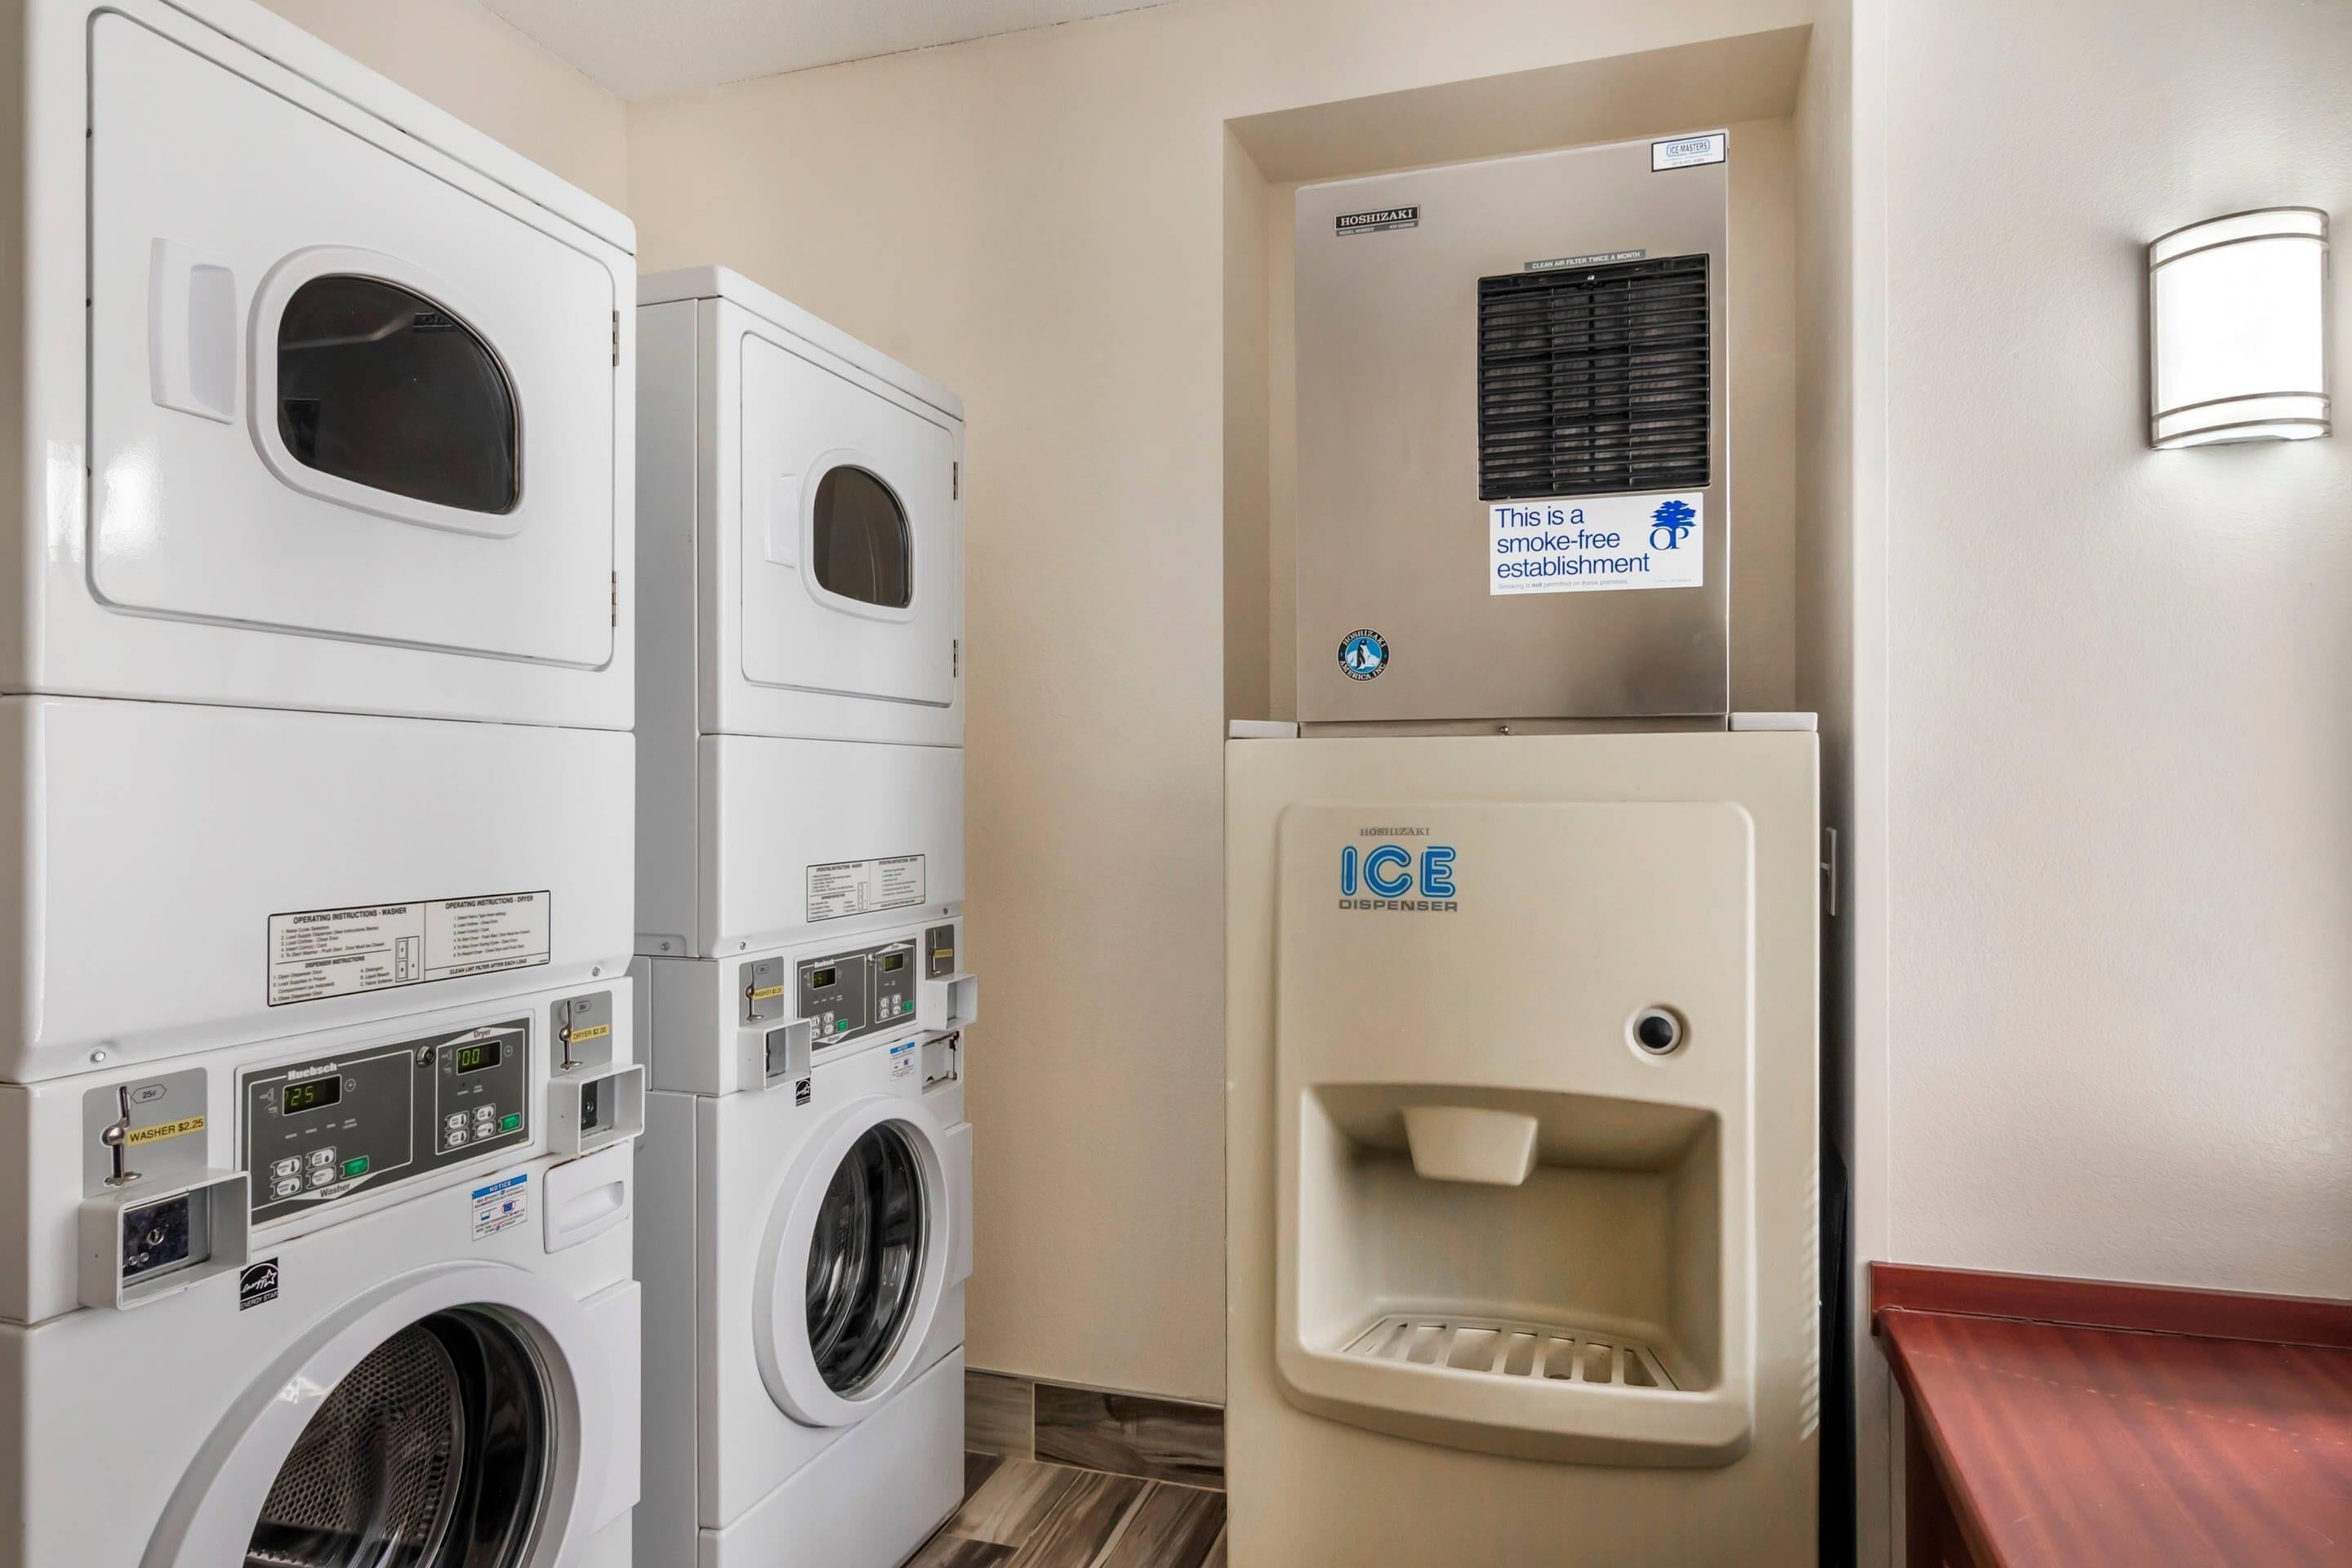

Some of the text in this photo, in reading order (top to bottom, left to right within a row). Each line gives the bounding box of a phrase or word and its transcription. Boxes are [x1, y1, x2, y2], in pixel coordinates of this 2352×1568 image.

[1670, 142, 1707, 154] ICE-MASTERS
[1341, 209, 1413, 225] HOSHIZAKI
[1495, 506, 1584, 528] This is a
[1497, 529, 1620, 554] smoke-free
[1498, 554, 1650, 578] establishment
[1343, 630, 1387, 647] HOSHIZAKI
[1361, 828, 1431, 836] HOSHIZAKI
[1341, 844, 1456, 898] ICE
[446, 899, 475, 909] OPERATING
[477, 897, 513, 906] INSTRUCTIONS
[517, 895, 533, 903] DRYER
[1339, 900, 1457, 911] DISPENSER
[293, 913, 331, 924] OPERATING
[332, 910, 377, 921] INSTRUCTIONS
[382, 907, 407, 916] WASHER
[474, 1030, 491, 1039] Dryer
[573, 1031, 592, 1039] DRYER
[287, 1062, 337, 1080] Huebsch
[130, 1119, 203, 1142] WASHER $2.25
[320, 1184, 350, 1197] Washer
[490, 1181, 511, 1192] NOTICE
